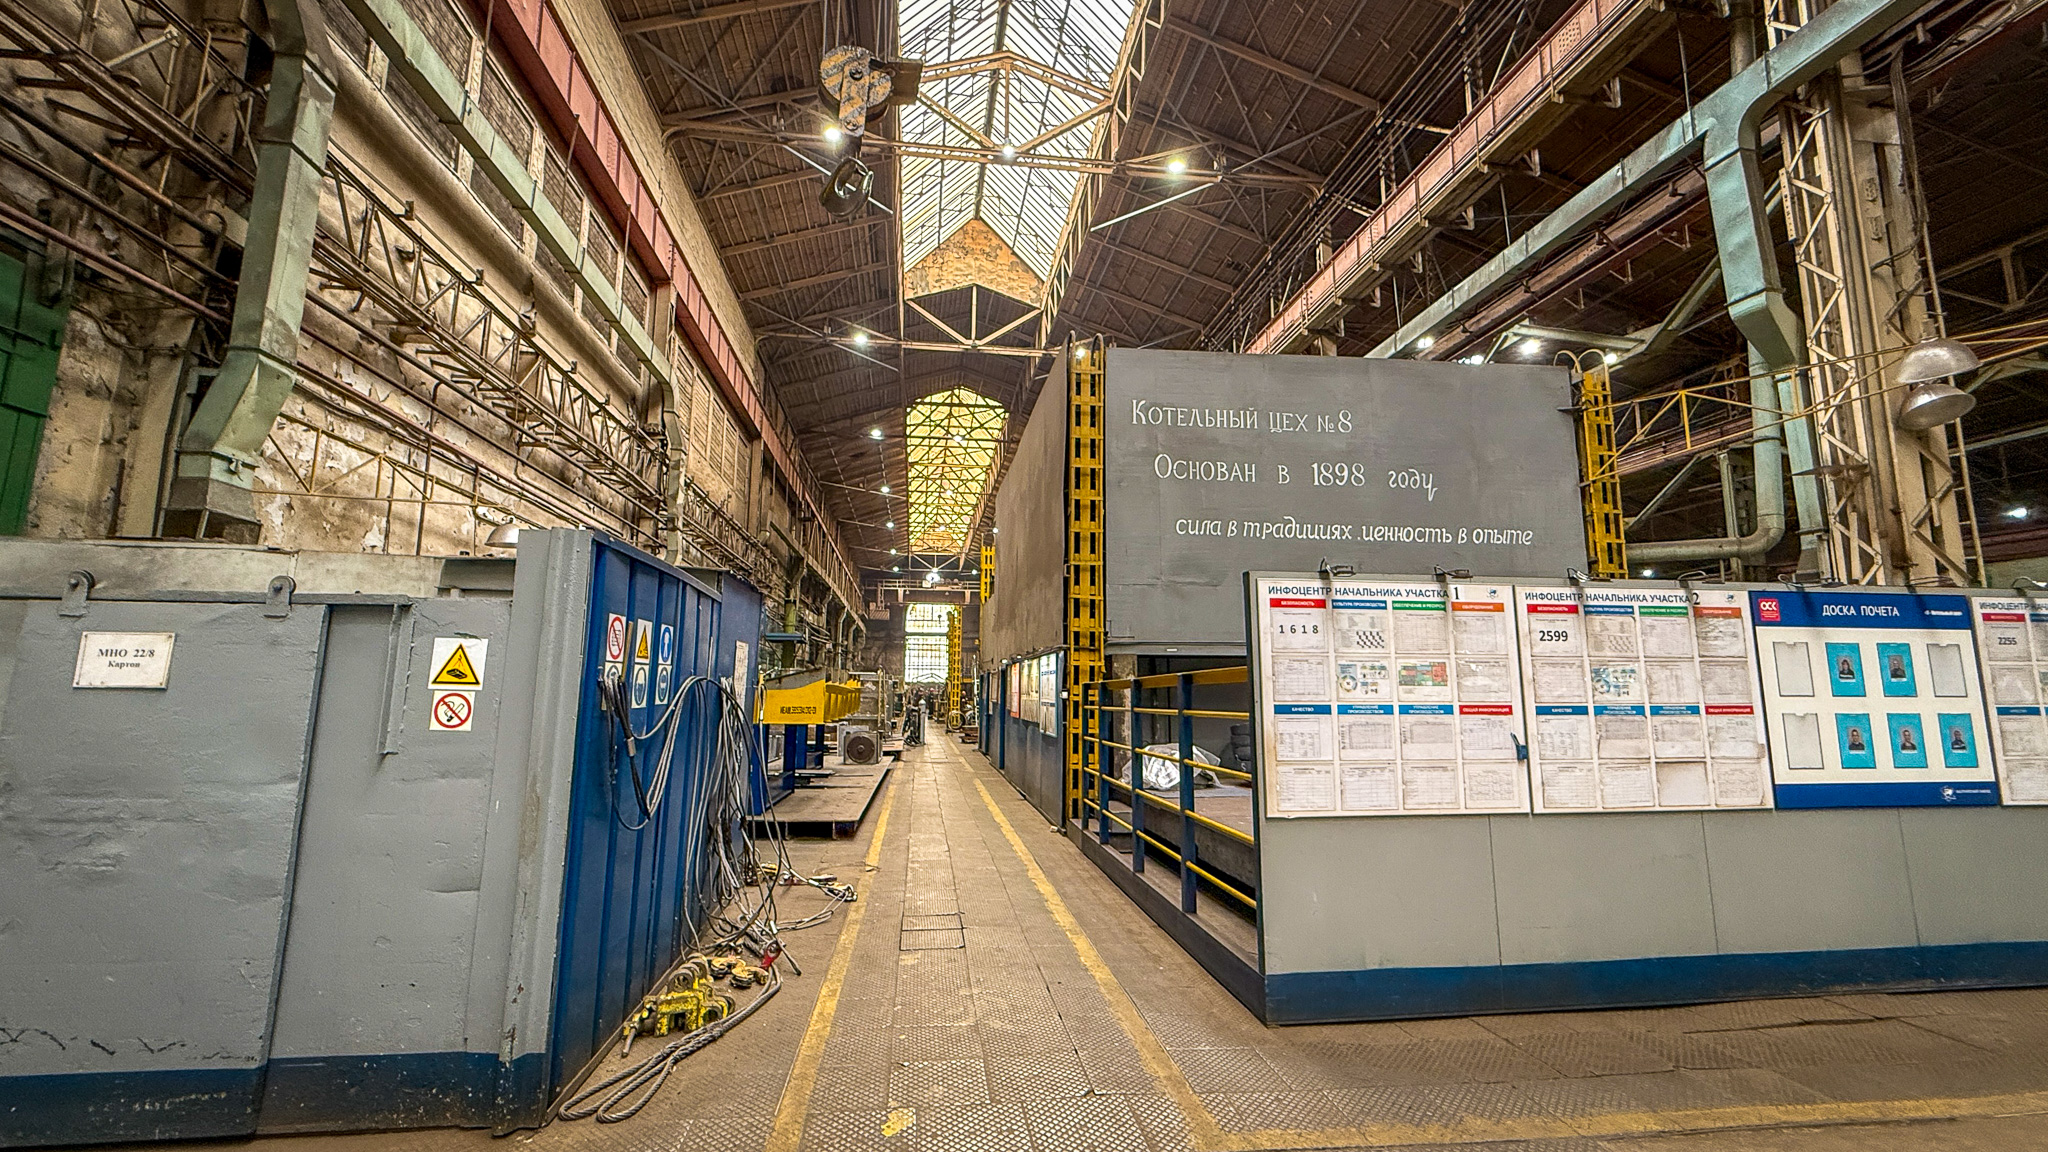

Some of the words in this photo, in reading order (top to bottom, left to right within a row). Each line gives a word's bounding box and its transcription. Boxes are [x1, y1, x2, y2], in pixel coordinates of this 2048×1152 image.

[1311, 462, 1366, 487] 1898
[1388, 469, 1438, 502] году
[1176, 518, 1222, 536] сила
[1227, 519, 1238, 538] в
[1243, 516, 1353, 541] традициях
[1457, 527, 1468, 545] в
[1472, 528, 1534, 546] опыте
[1268, 586, 1332, 596] ИНФОЦЕНТР
[1335, 587, 1403, 598] НАЧАЛЬНИКА
[1405, 588, 1449, 598] УЧАСТКА
[1453, 586, 1460, 600] 1
[1525, 592, 1584, 602] ИНФОЦЕНТР
[1586, 593, 1648, 603] НАЧАЛЬНИКА
[1649, 594, 1691, 604] УЧАСТКА
[1692, 592, 1700, 605] 2
[1760, 601, 1778, 611] ОСК
[1822, 604, 1857, 617] ДОСКА
[1860, 605, 1900, 617] ПОЧЕТА
[1979, 602, 2030, 611] ИНФОЦЕНТР
[1538, 630, 1569, 642] 2599
[97, 648, 128, 658] МНО
[133, 648, 156, 658] 22/8
